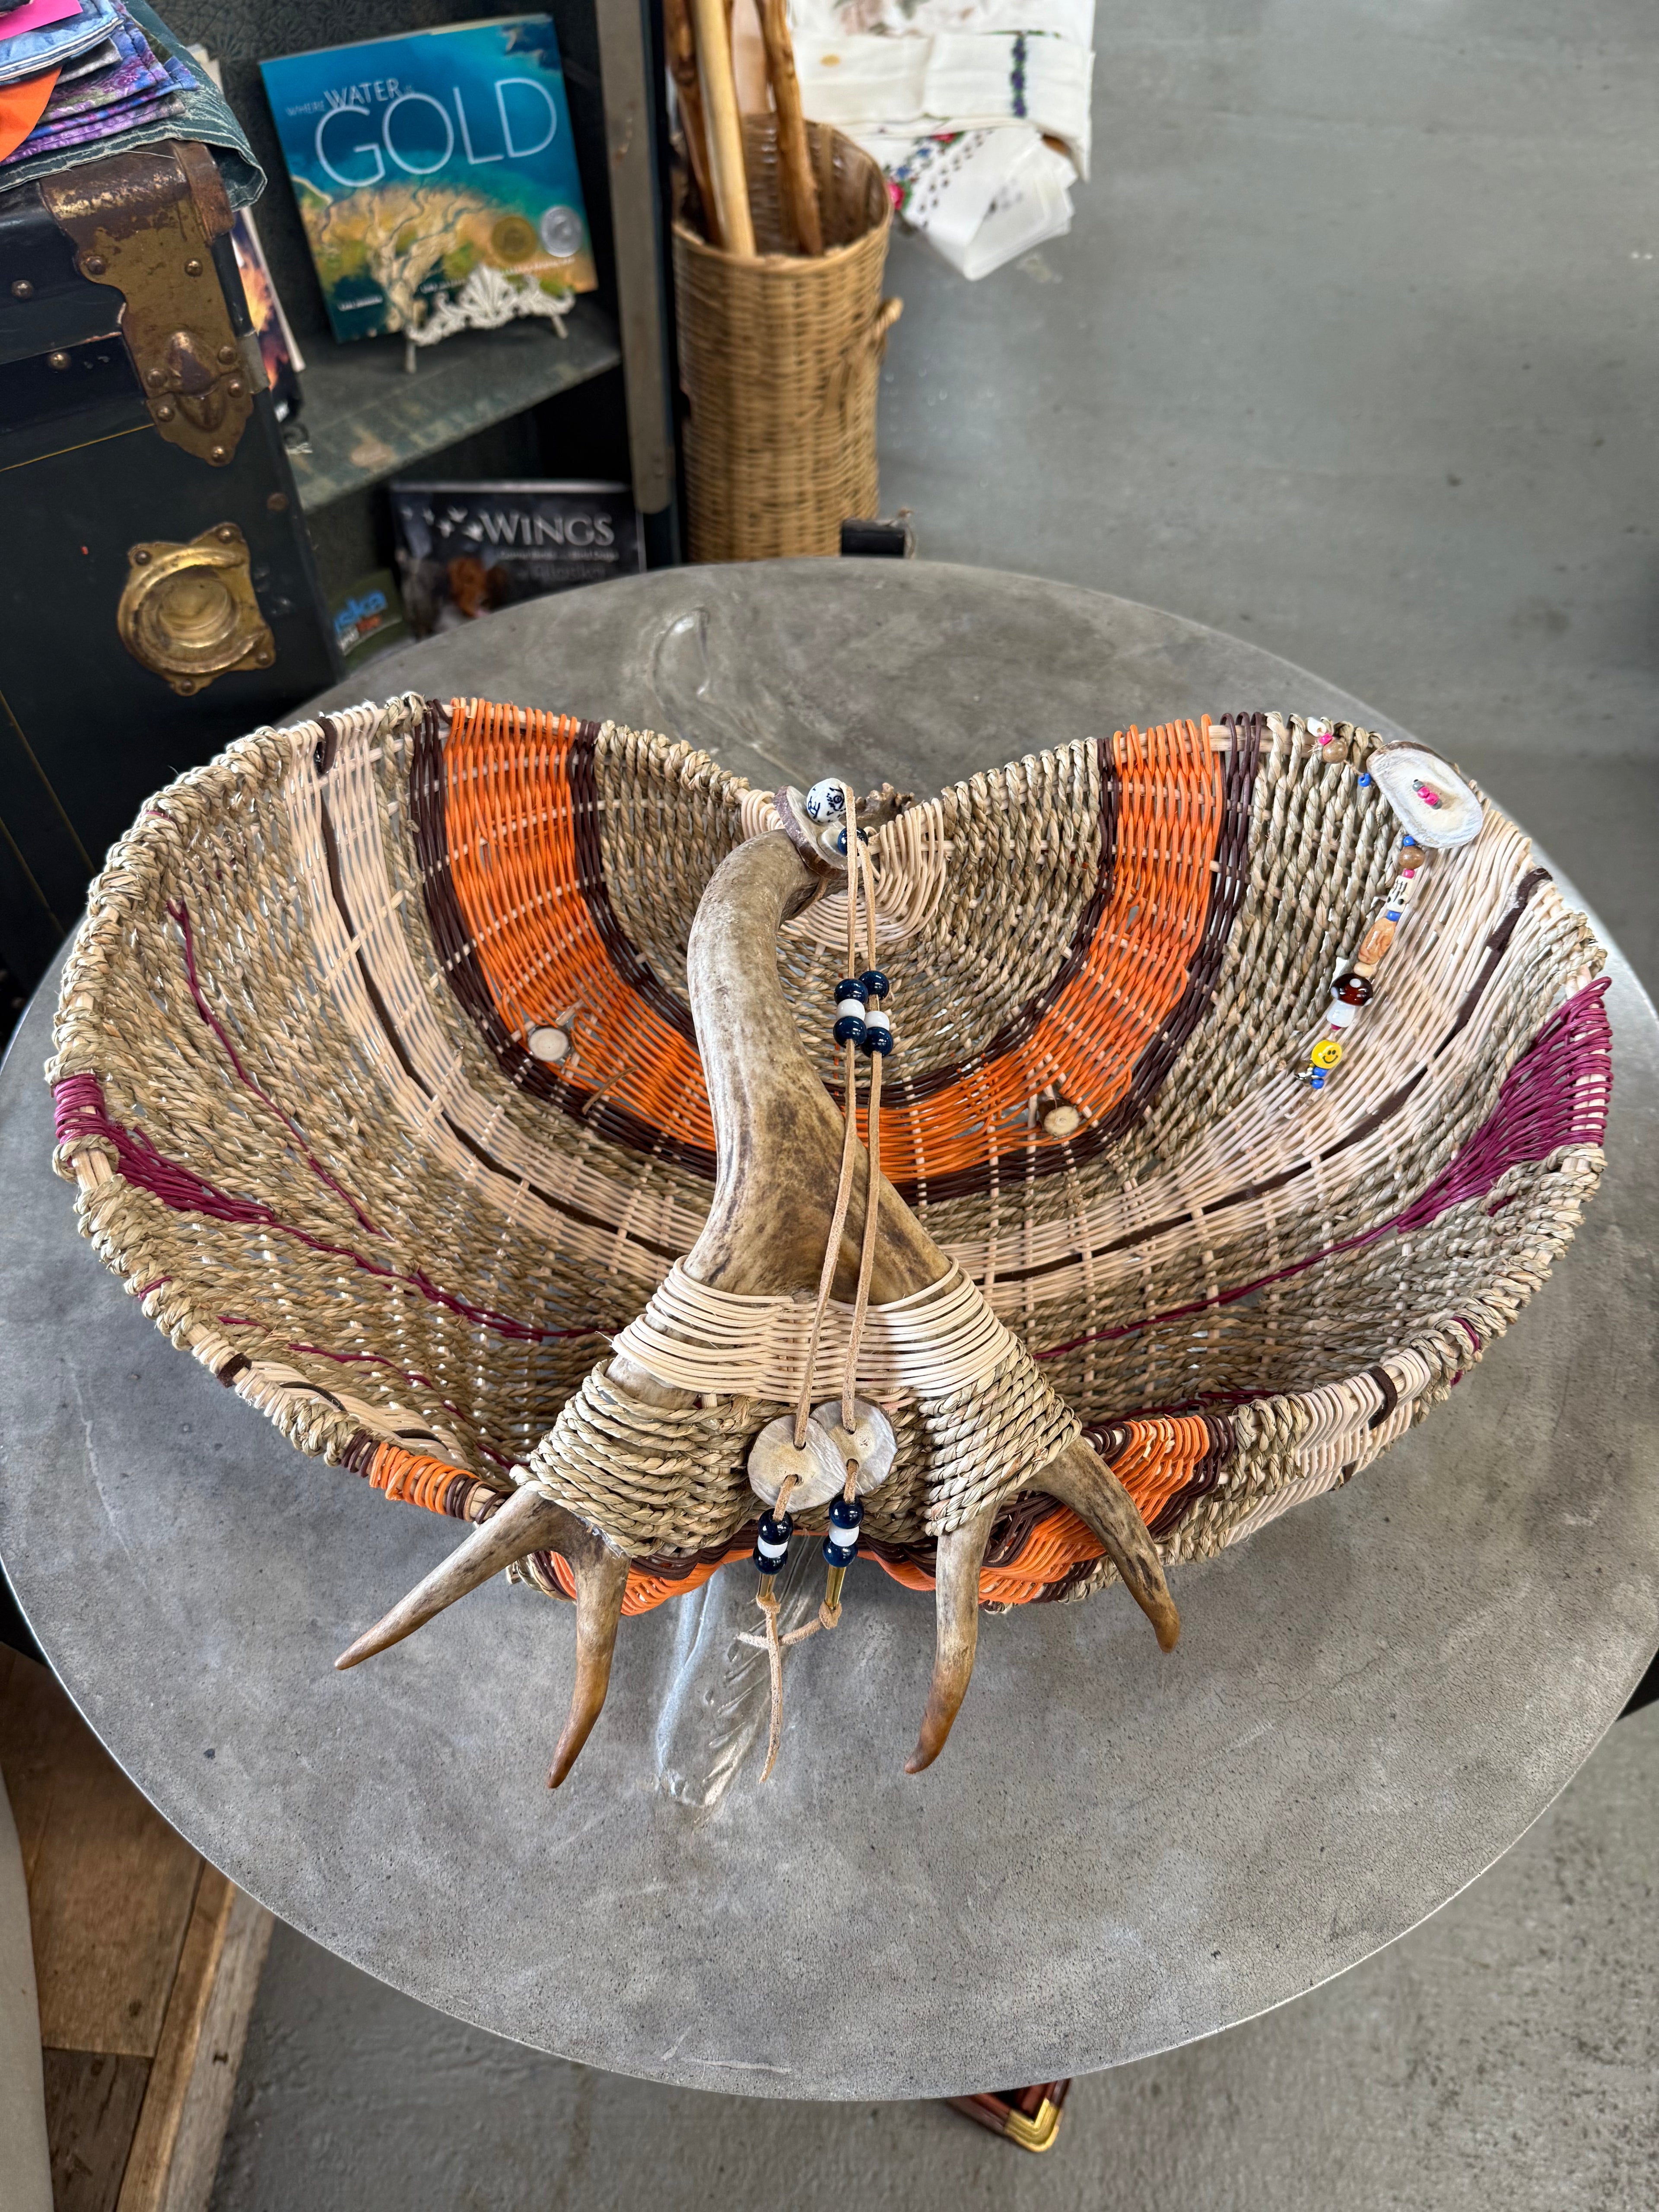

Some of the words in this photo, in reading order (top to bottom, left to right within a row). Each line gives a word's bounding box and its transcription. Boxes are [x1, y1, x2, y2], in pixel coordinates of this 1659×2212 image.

[286, 100, 325, 117] WHERE
[323, 78, 404, 109] WATER
[315, 77, 557, 188] GOLD
[479, 510, 614, 546] WINGS
